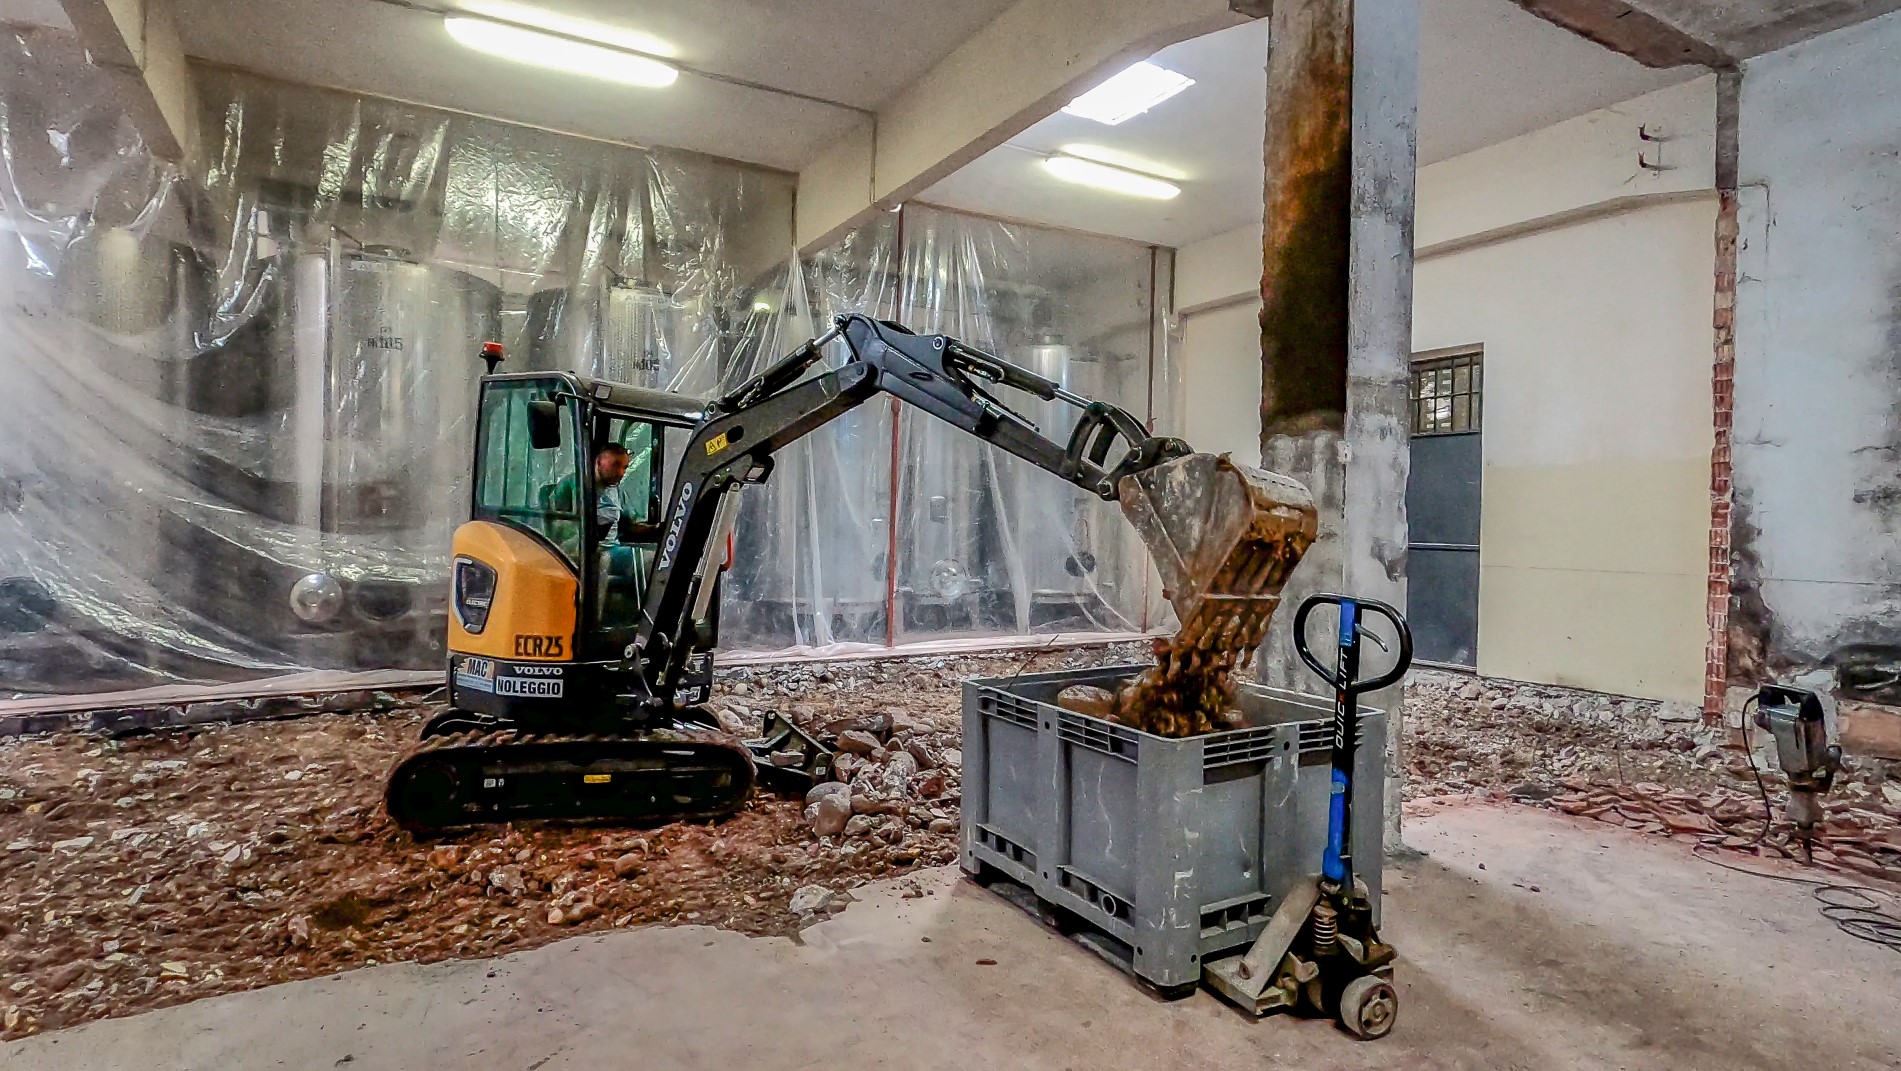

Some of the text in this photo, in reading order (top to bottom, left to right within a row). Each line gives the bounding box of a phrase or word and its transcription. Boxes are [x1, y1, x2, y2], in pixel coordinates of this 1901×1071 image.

[658, 482, 693, 570] VOLVO
[514, 634, 563, 657] ECR25
[513, 666, 563, 675] VOLVO
[497, 679, 561, 695] NOLEGGIO
